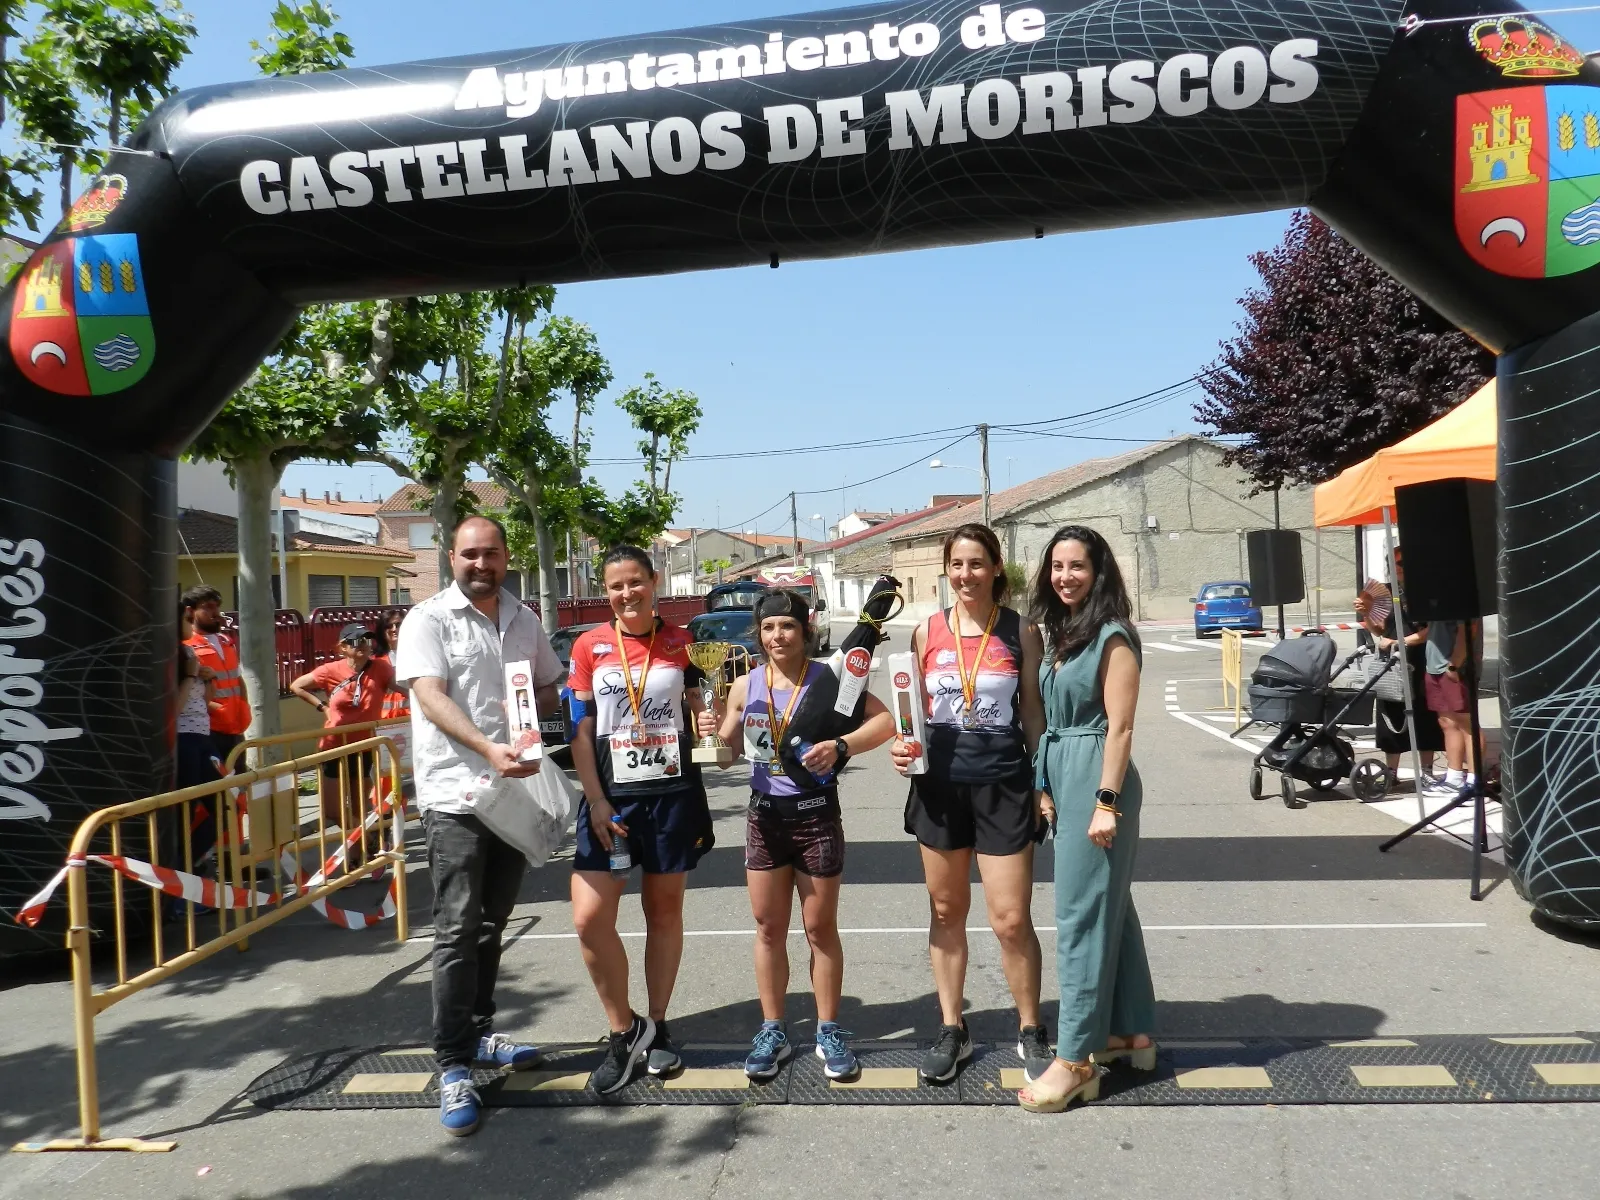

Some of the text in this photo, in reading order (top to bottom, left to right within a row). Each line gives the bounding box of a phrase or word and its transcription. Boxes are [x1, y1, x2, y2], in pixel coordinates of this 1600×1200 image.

[453, 4, 1046, 118] Ayuntamiento de
[240, 37, 1319, 215] CASTELLANOS DE MORISCOS
[626, 747, 667, 769] 344
